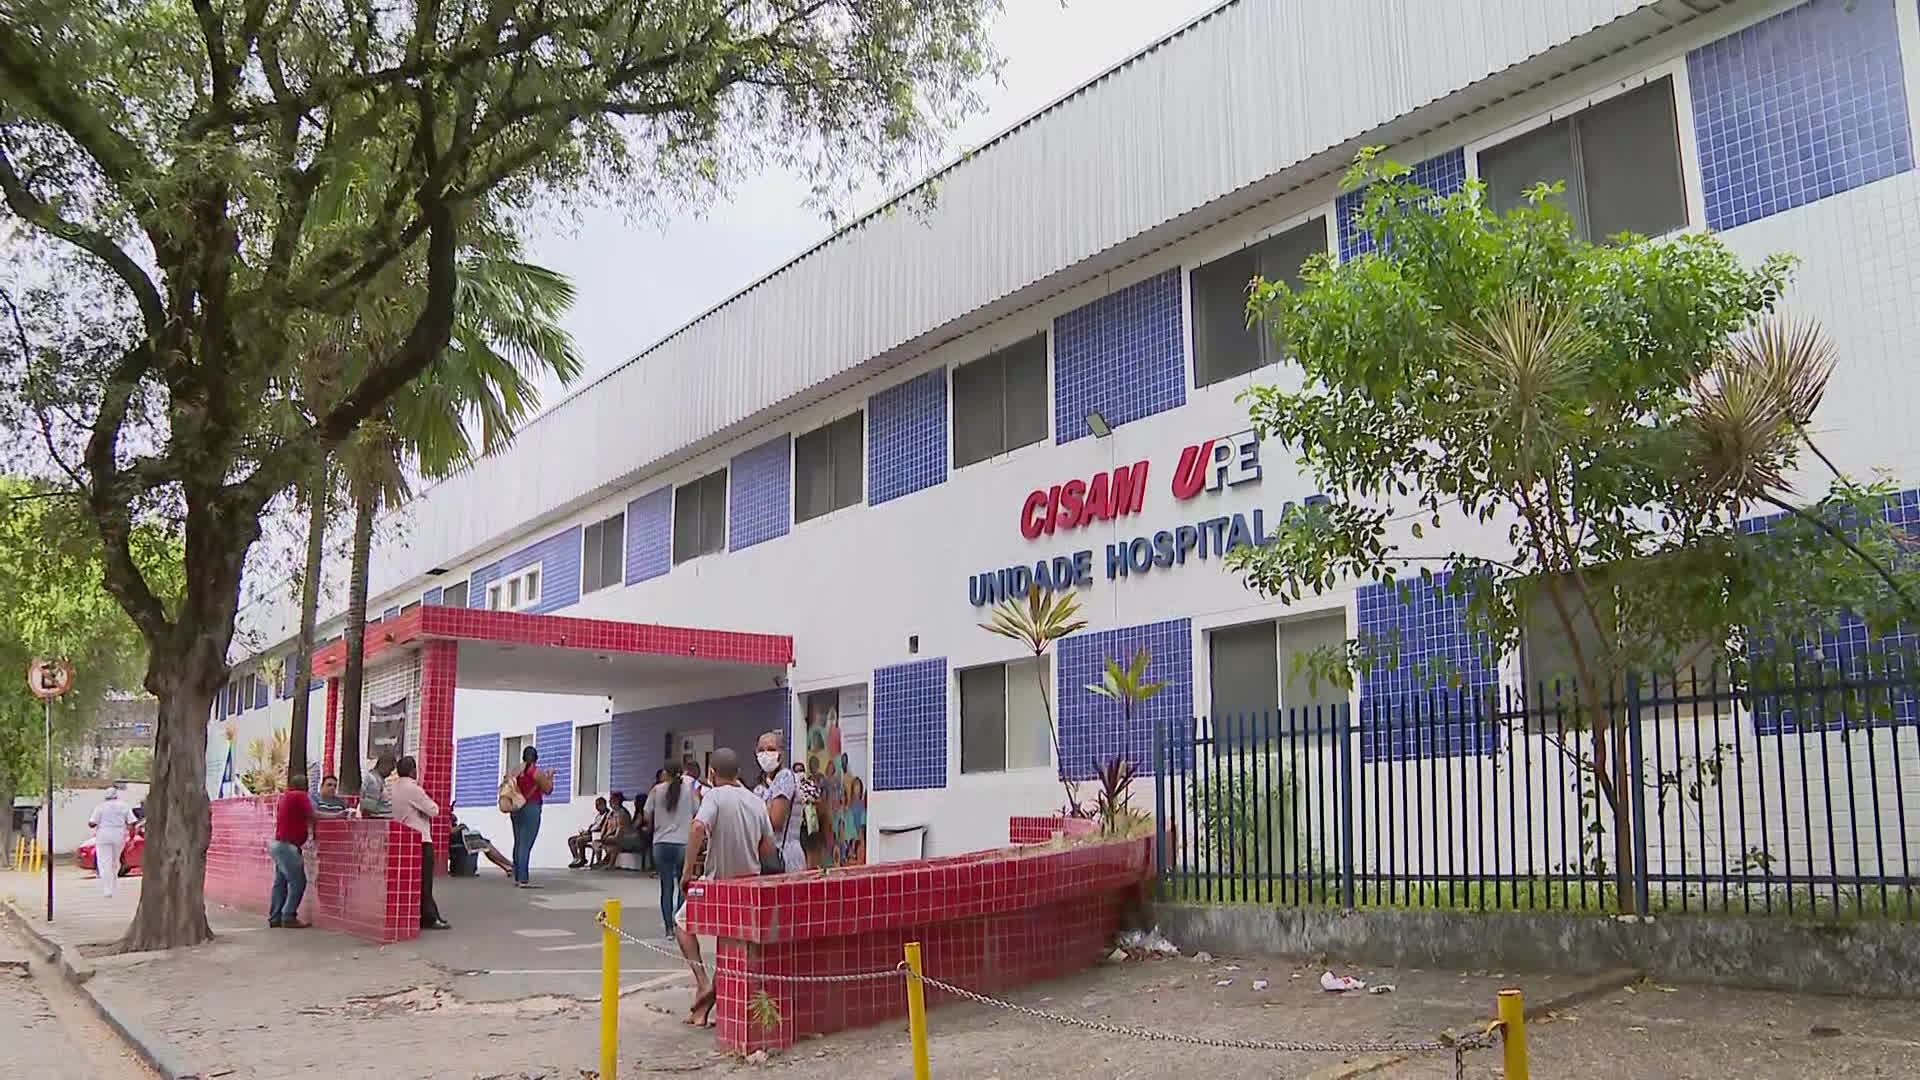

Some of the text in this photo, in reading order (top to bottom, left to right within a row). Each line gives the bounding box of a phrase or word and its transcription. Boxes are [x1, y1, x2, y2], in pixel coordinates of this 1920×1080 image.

[1020, 430, 1263, 539] CISAM UPE
[968, 551, 1094, 607] UNIDADE
